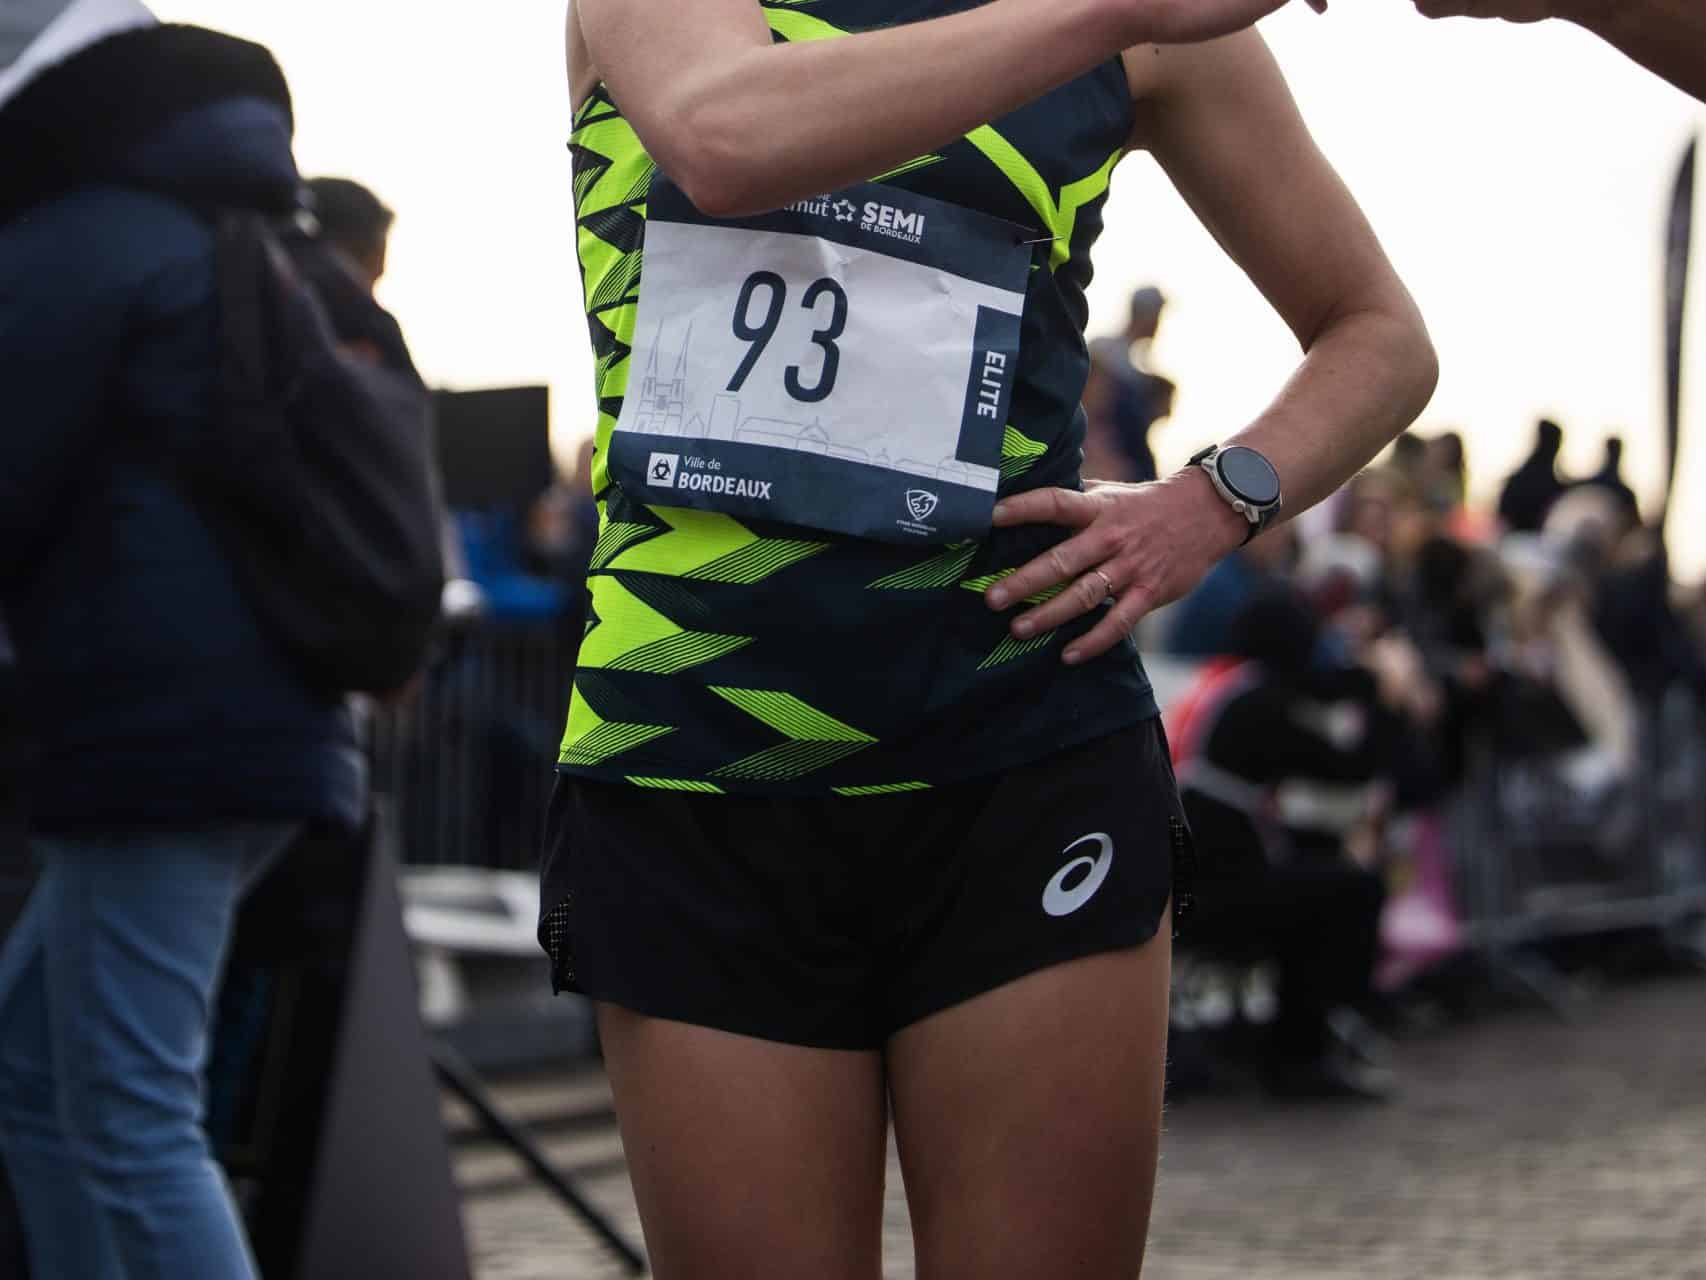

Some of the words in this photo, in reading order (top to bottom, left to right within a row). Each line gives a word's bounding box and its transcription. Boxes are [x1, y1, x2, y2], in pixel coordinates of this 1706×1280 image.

[860, 222, 873, 232] DE
[873, 225, 921, 245] BORDEAUX
[862, 201, 925, 236] SEMI
[726, 270, 848, 403] 93
[976, 350, 1007, 419] ELITE
[684, 455, 705, 469] Ville
[707, 457, 721, 470] de
[678, 472, 772, 500] BORDEAUX
